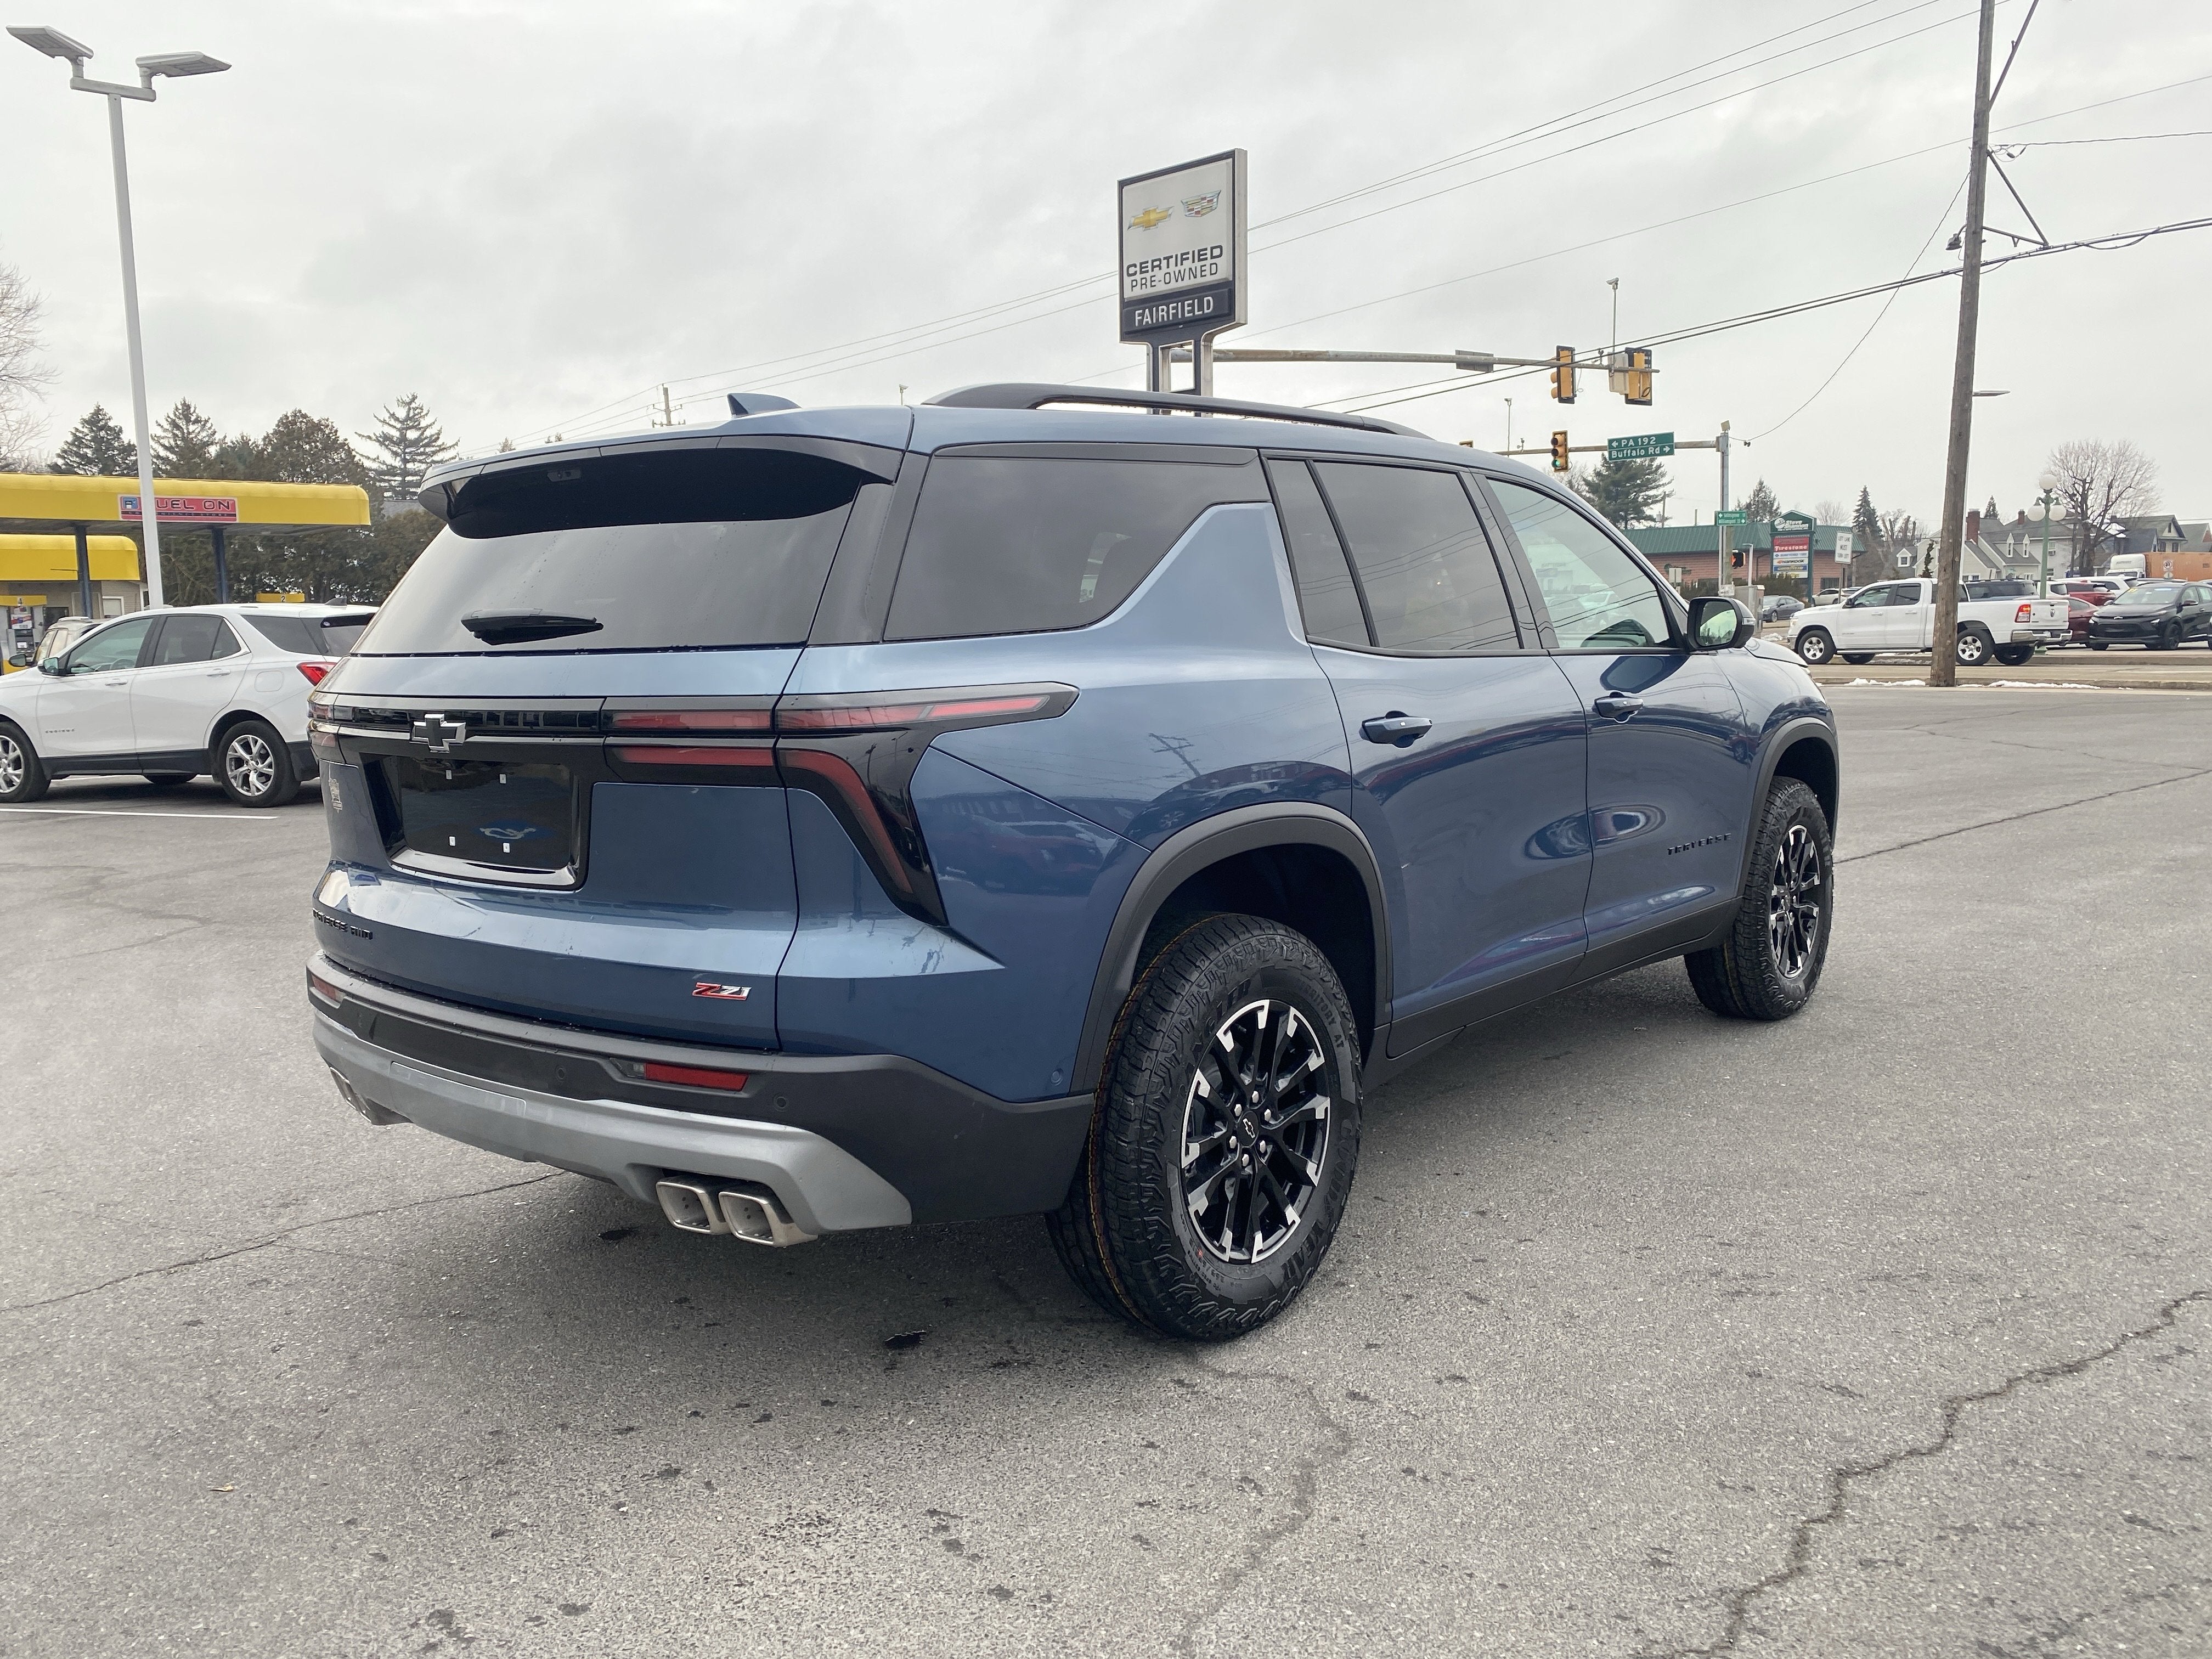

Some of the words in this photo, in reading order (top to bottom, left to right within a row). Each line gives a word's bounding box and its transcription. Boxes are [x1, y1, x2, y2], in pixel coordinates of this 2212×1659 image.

[1126, 245, 1223, 277] CERTIFIED
[1131, 262, 1218, 292] PRE-OWNED
[1135, 296, 1214, 326] FAIRFIELD
[1638, 437, 1656, 445] 192
[1611, 448, 1645, 458] Buffalo
[1648, 446, 1660, 455] Rd
[156, 499, 194, 509] UEL
[203, 500, 230, 510] ON
[692, 982, 752, 1001] Z71
